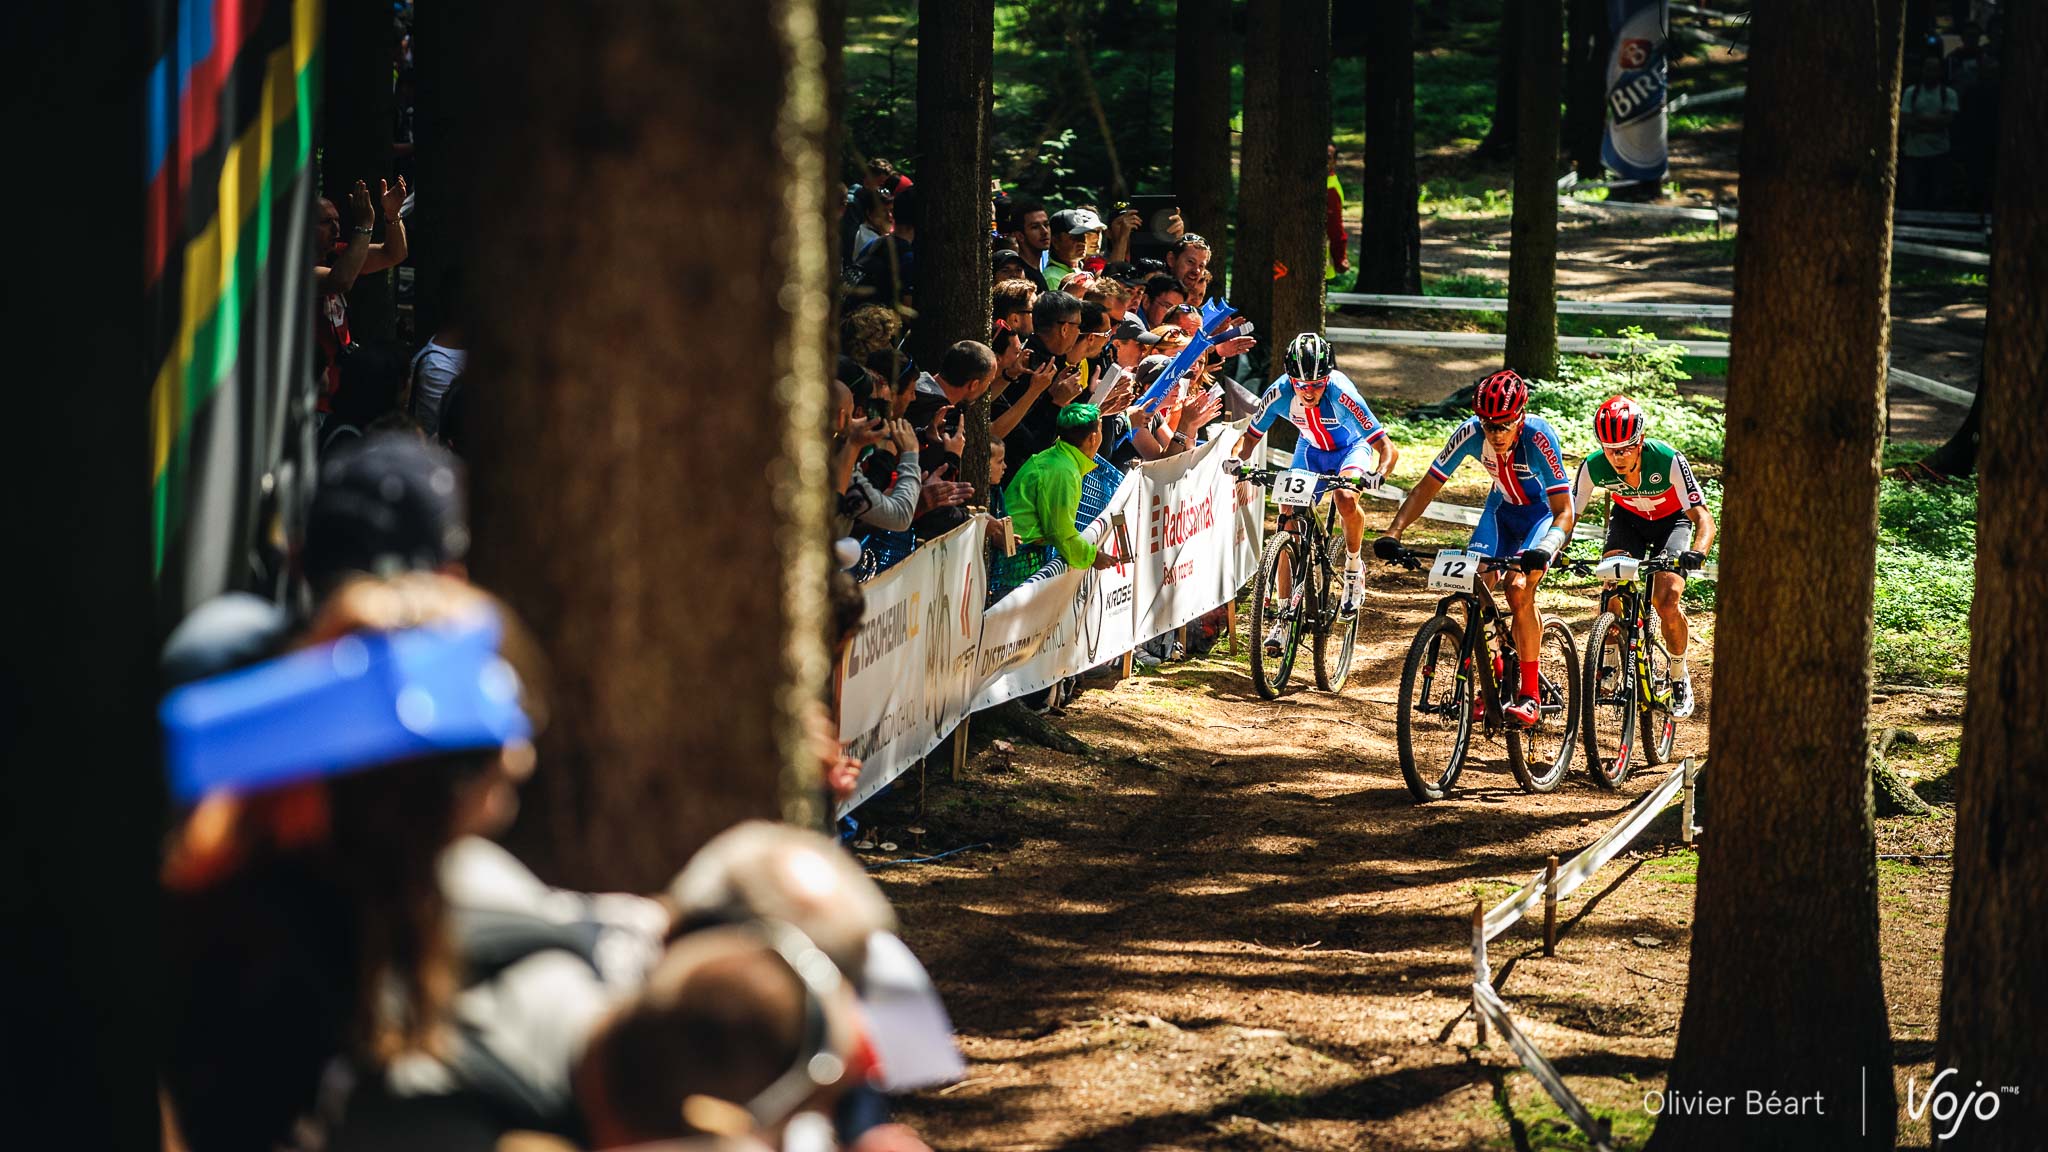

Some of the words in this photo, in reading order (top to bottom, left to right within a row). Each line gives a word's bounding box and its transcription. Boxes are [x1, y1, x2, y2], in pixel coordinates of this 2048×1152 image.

[1338, 392, 1374, 430] STRABAG
[1440, 424, 1471, 463] SILVINI
[1532, 431, 1565, 479] STRABAG
[1284, 477, 1306, 494] 13
[1442, 561, 1467, 579] 12
[1612, 562, 1621, 578] 1
[1105, 583, 1132, 612] KROSS
[1627, 650, 1636, 675] SWISS
[1626, 674, 1634, 689] DT
